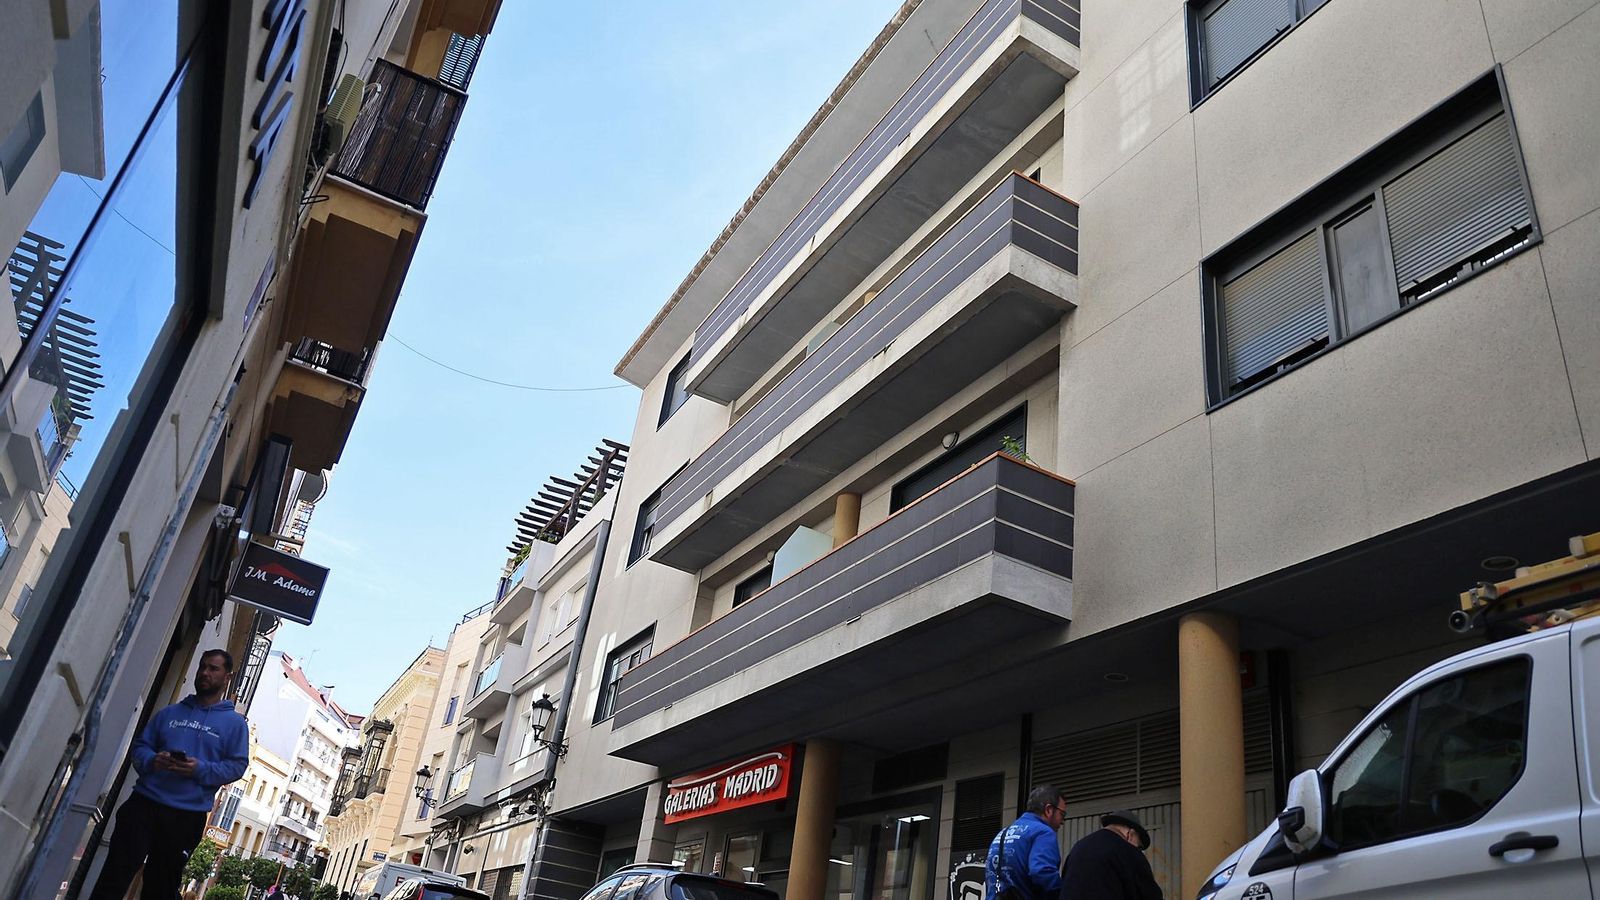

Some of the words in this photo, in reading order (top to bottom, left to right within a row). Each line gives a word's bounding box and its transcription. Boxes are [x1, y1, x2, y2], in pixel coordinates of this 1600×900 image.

[244, 566, 267, 582] JM
[664, 781, 717, 815] GALERIAS
[723, 763, 778, 799] MADRID
[1249, 884, 1264, 896] 524
